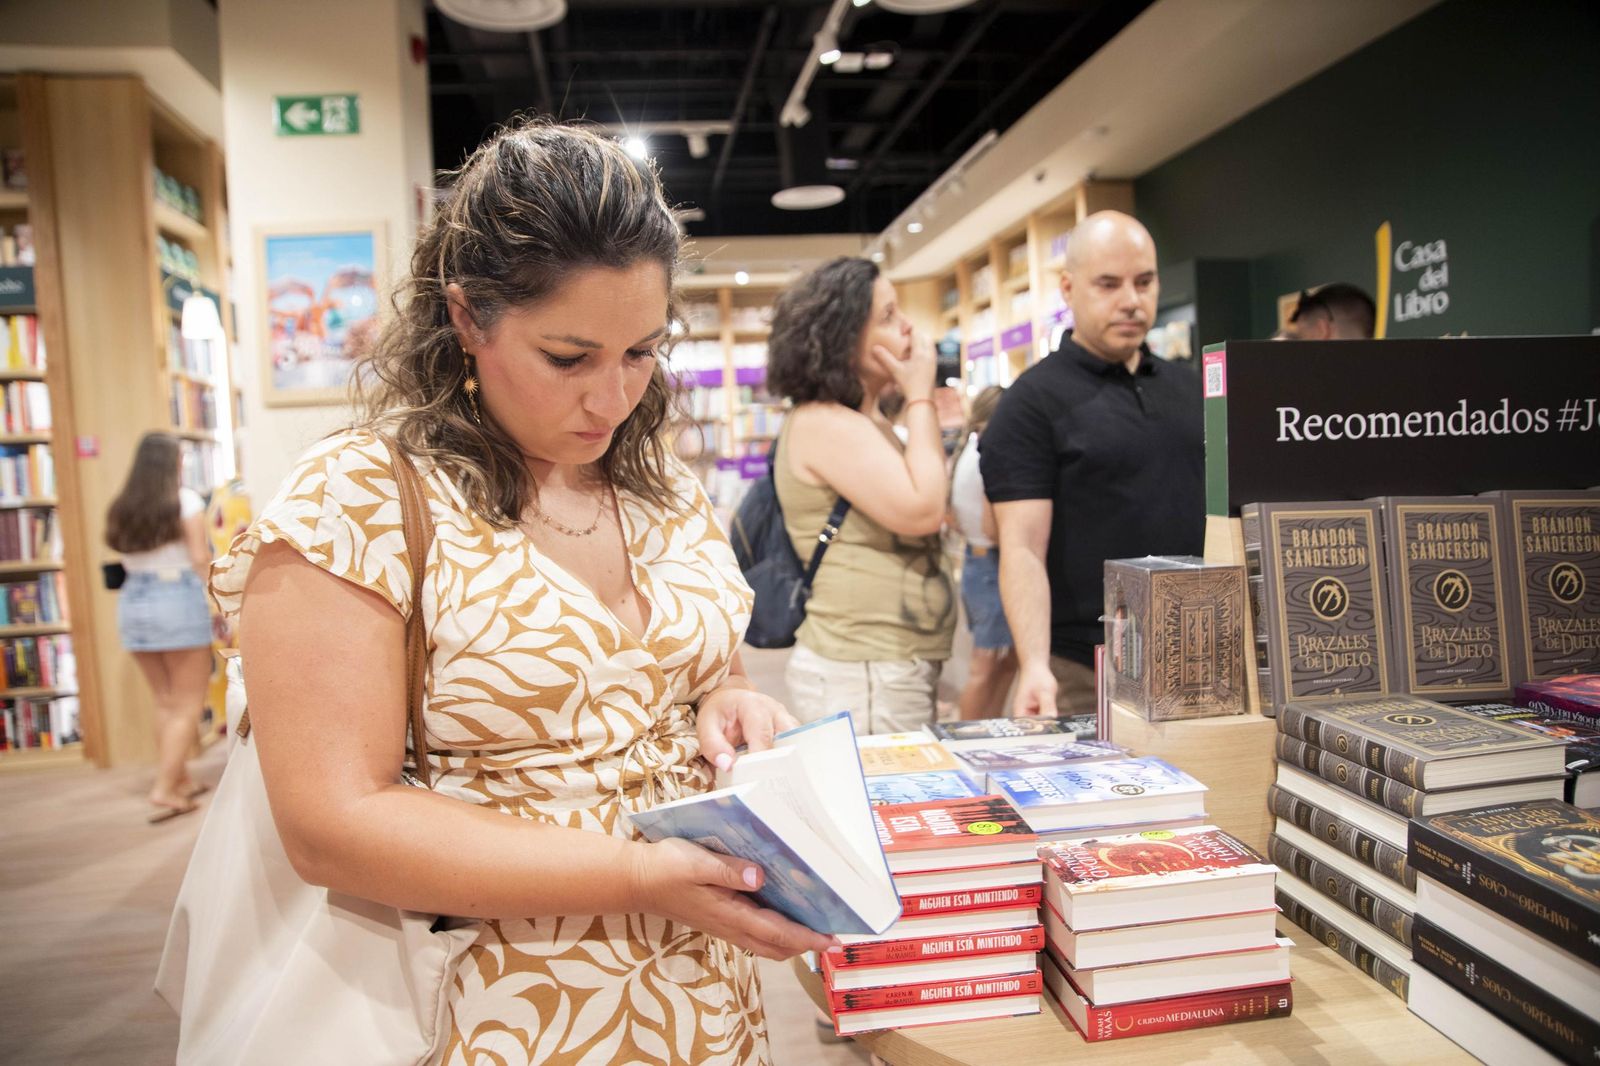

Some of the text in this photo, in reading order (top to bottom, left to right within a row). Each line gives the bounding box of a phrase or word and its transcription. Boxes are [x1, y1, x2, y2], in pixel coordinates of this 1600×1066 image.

[1395, 240, 1447, 272] Casa
[1419, 261, 1448, 291] del
[1395, 290, 1449, 322] Libro
[1276, 398, 1600, 442] Recomendados #J
[1417, 522, 1479, 541] BRANDON
[1533, 516, 1591, 534] BRANDON
[1292, 528, 1356, 548] BRANDON
[1286, 547, 1366, 568] SANDERSON
[1410, 541, 1488, 560] SANDERSON
[1298, 634, 1369, 657] BRAZALES
[1422, 626, 1491, 648] BRAZALES
[1306, 651, 1371, 674] DE DUELO
[1429, 643, 1493, 665] DE DUELO
[889, 815, 929, 833] ESTÁ
[918, 809, 962, 836] ALGUIEN
[1182, 840, 1217, 860] MAAS
[1193, 834, 1234, 857] SARAH
[1067, 846, 1111, 879] CIUDAD
[1478, 874, 1508, 897] CAOS
[919, 895, 951, 910] ALGUIEN
[953, 891, 971, 906] ESTÁ
[974, 889, 1019, 904] MINTIENDO
[1518, 894, 1570, 931] IMPERIO
[922, 935, 1022, 955] ALGUIEN ESTÁ MINTIENDO
[920, 980, 1020, 1001] ALGUIEN ESTÁ MINTIENDO
[1482, 975, 1512, 1001] CAOS
[1103, 1010, 1112, 1038] MAAS
[1137, 1007, 1225, 1026] CIUDAD MEDIALUNA
[1522, 1001, 1575, 1045] IMPERIO
